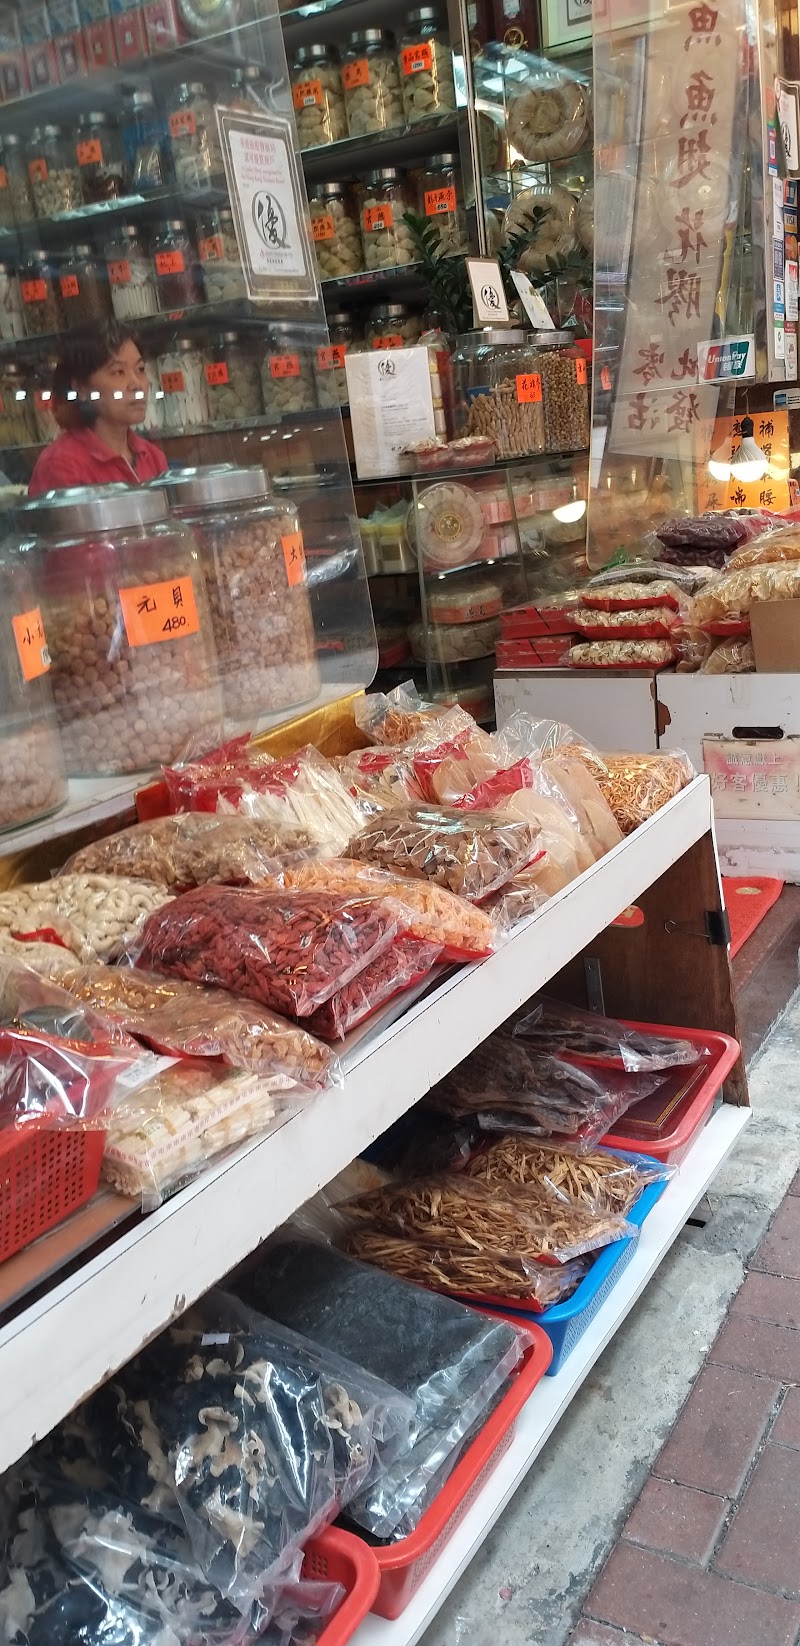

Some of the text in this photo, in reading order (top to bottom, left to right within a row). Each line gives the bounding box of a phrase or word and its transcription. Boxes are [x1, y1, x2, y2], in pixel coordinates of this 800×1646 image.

[707, 350, 746, 364] UnionPay
[530, 391, 536, 399] 65
[137, 586, 183, 614] 元貝
